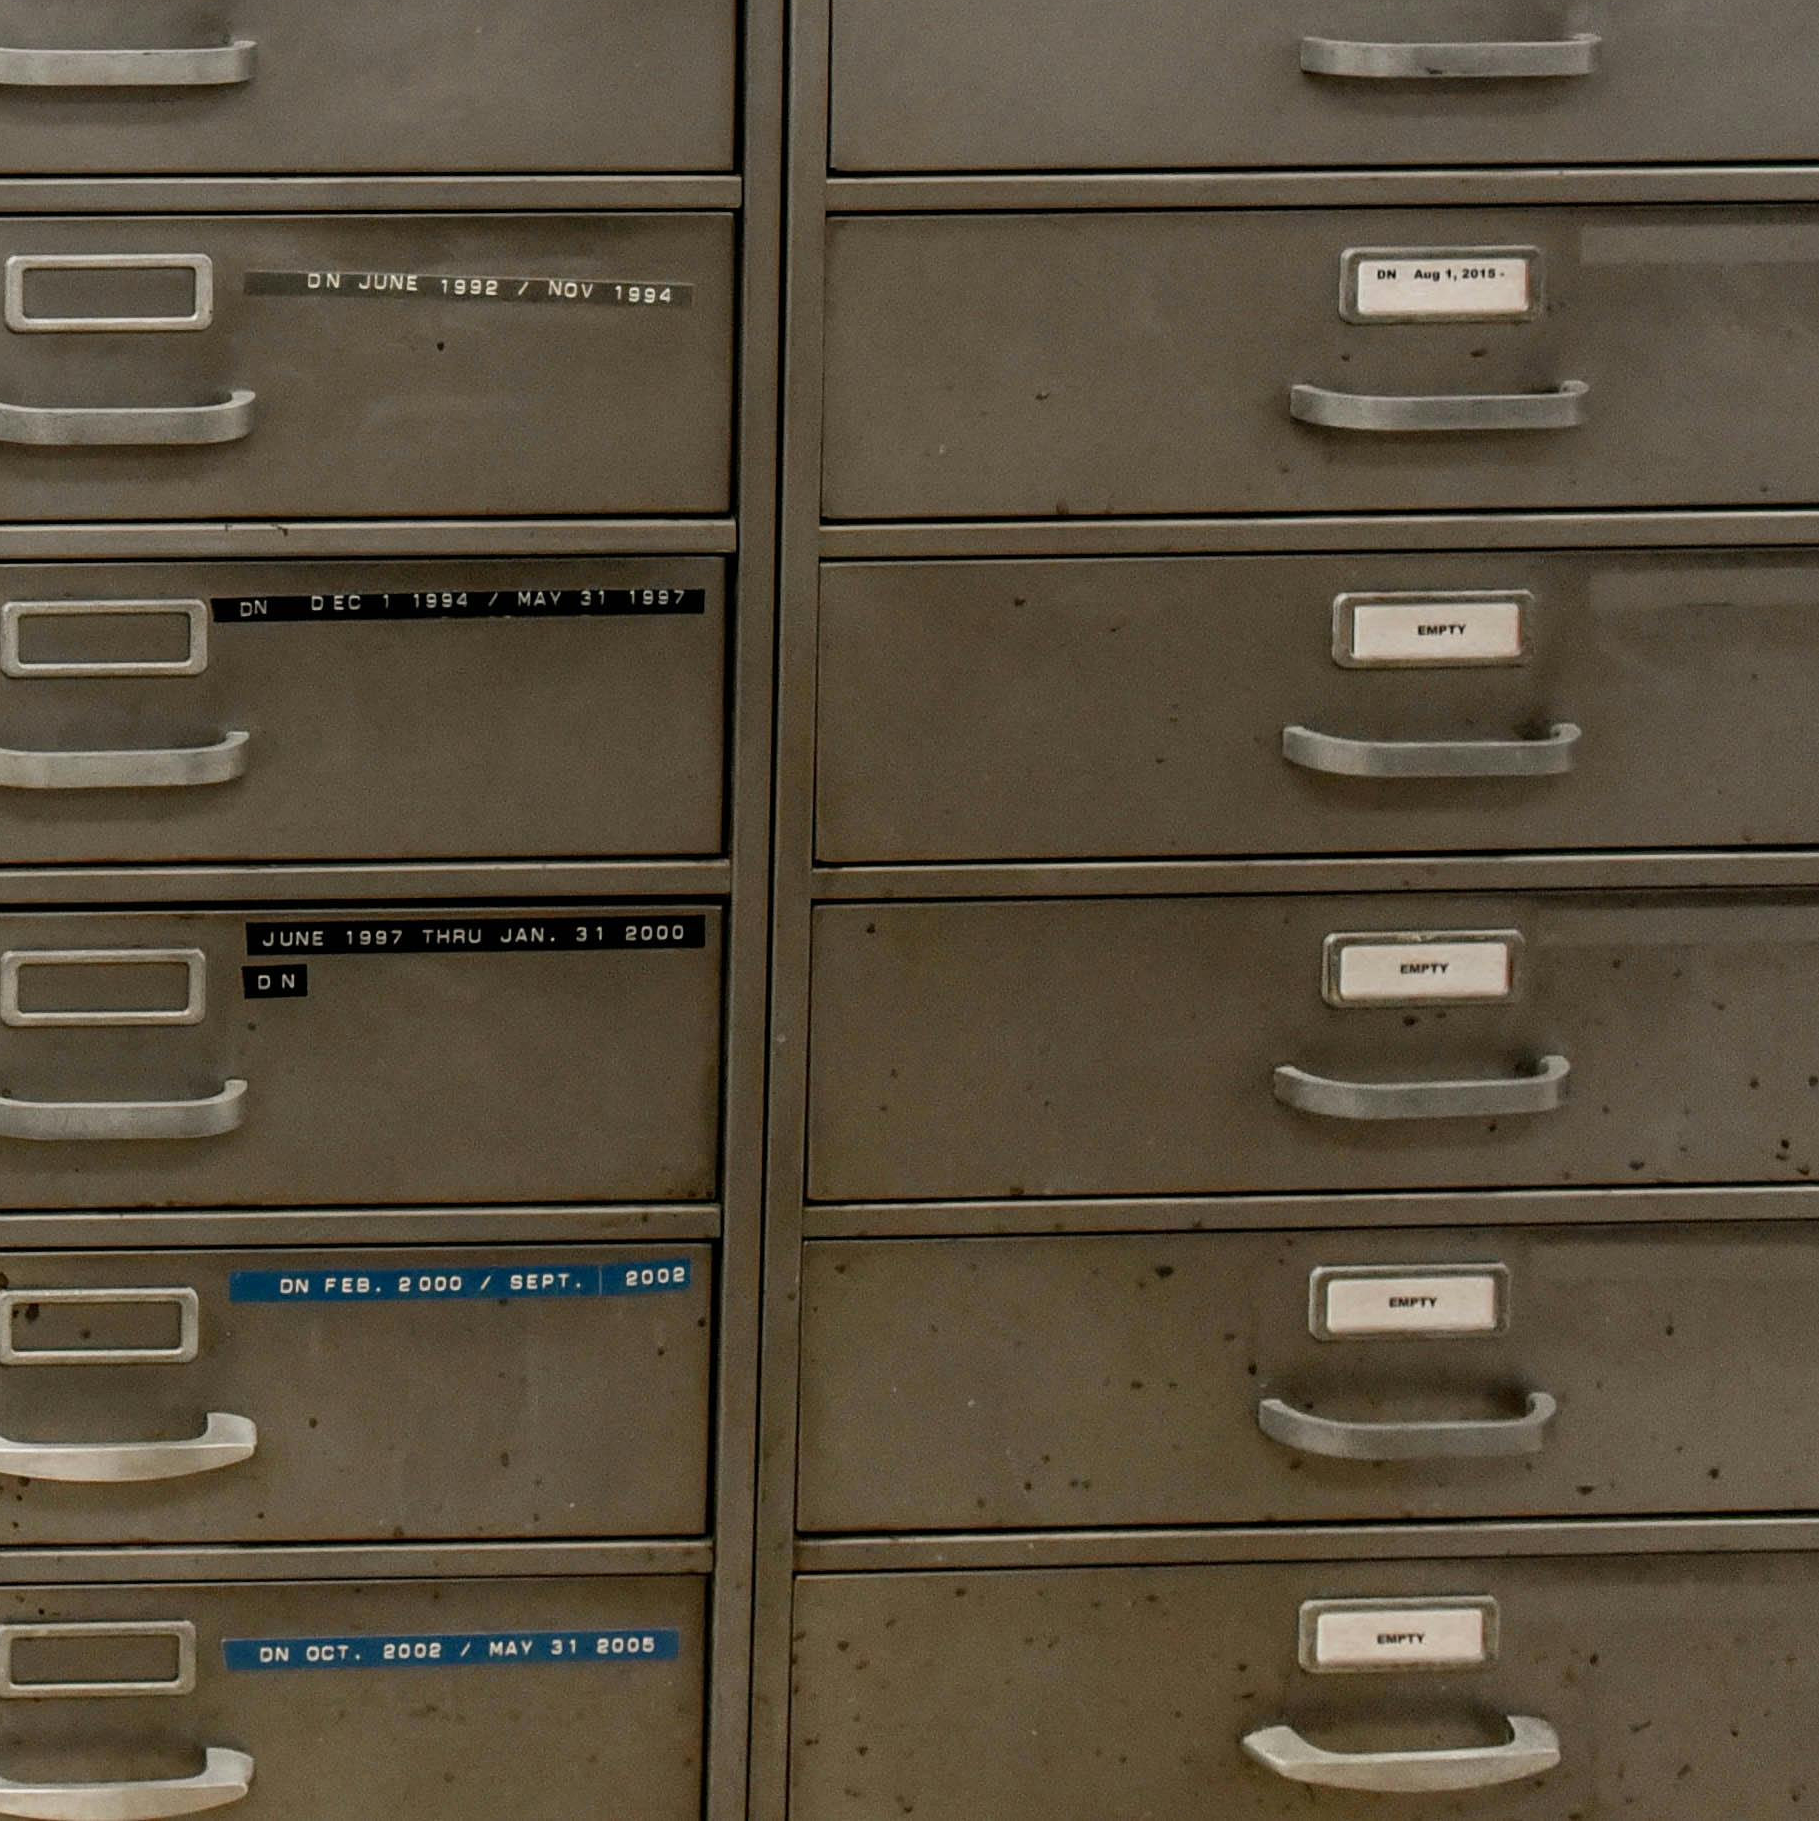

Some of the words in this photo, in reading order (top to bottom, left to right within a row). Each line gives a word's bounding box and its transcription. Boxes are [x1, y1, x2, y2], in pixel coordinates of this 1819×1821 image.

[307, 271, 341, 289] DN
[358, 273, 418, 291] JUNE
[441, 278, 498, 296] 1992
[547, 278, 594, 299] NOV
[615, 285, 671, 303] 1994
[1417, 624, 1466, 636] EMPTY
[262, 930, 324, 945] JUNE
[346, 929, 403, 944] 1997
[422, 928, 482, 943] THRU
[500, 927, 555, 941] JAN.
[576, 926, 603, 940] 31
[625, 924, 684, 940] 2000
[1399, 962, 1449, 975] EMPTY
[257, 973, 295, 988] DN
[279, 1277, 309, 1295] DN
[324, 1277, 381, 1293] FEB.
[510, 1272, 581, 1289] SEPT.
[625, 1266, 685, 1286] 2002
[1388, 1296, 1438, 1308] EMPTY
[1376, 1633, 1425, 1645] EMPTY
